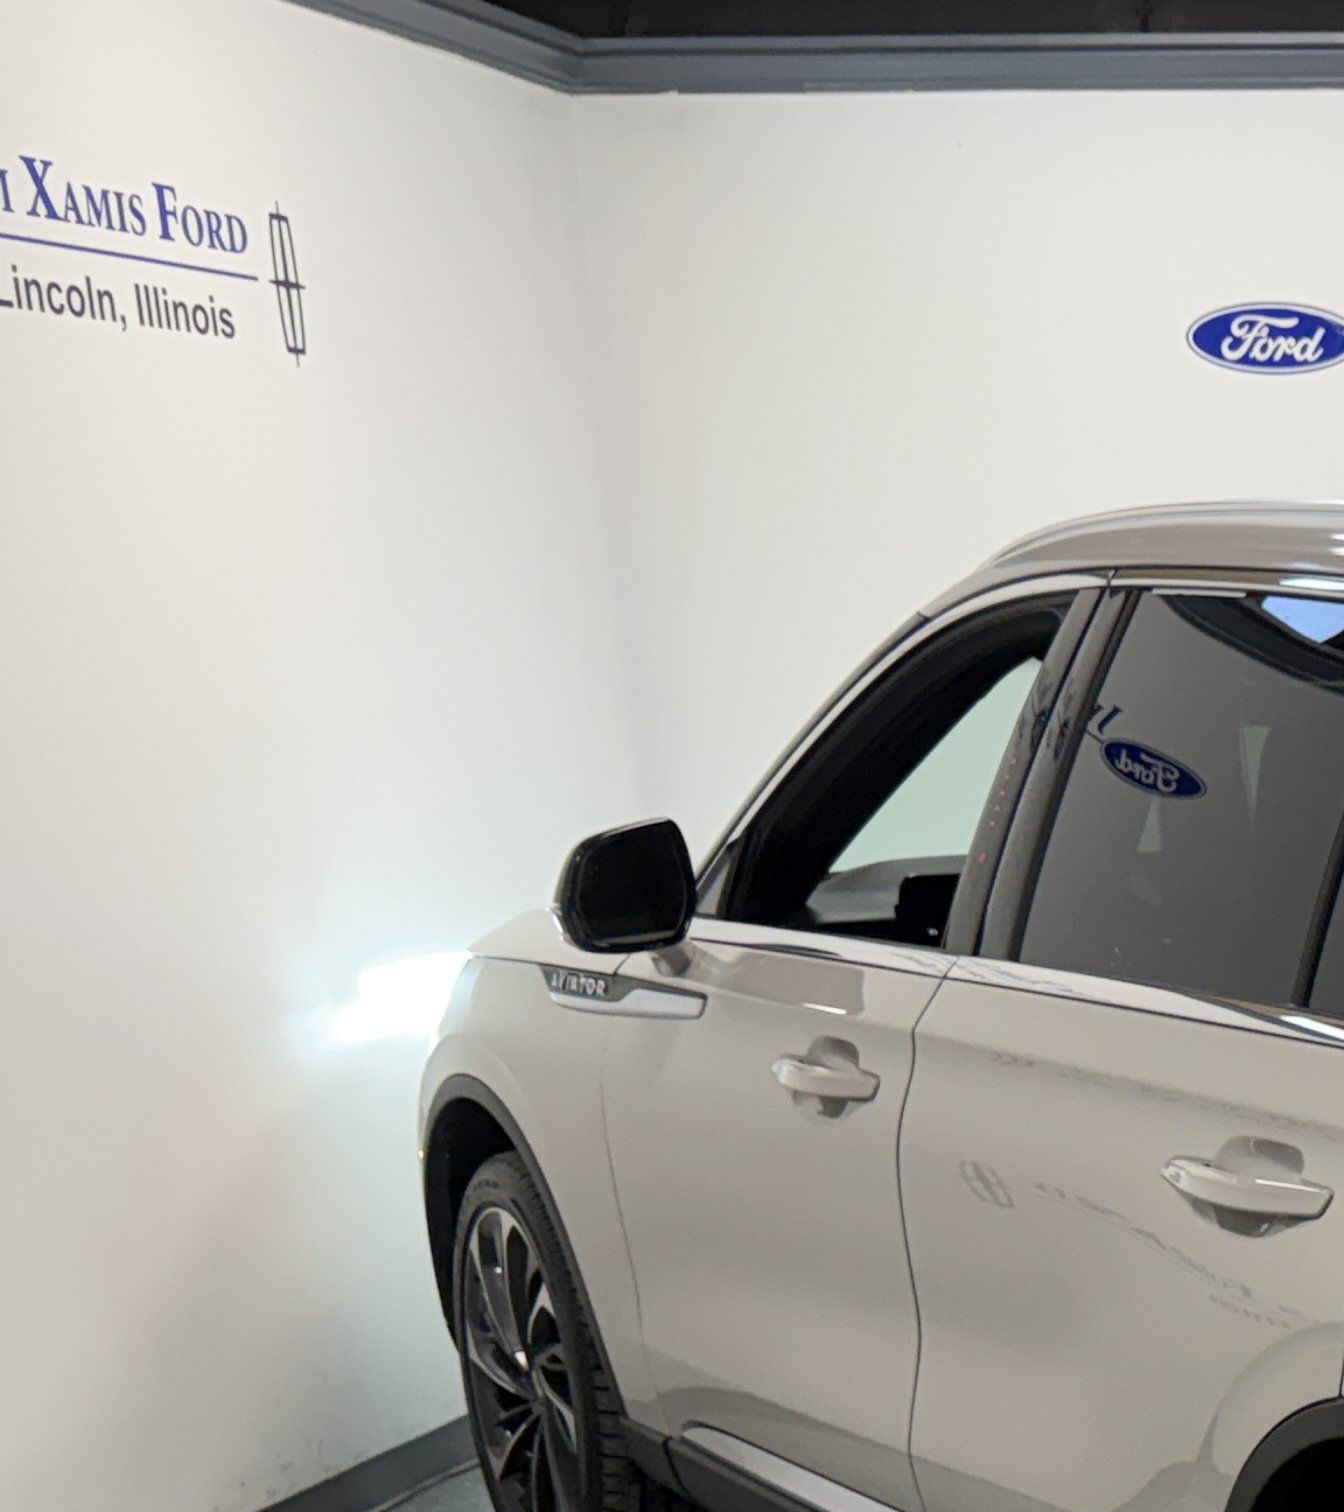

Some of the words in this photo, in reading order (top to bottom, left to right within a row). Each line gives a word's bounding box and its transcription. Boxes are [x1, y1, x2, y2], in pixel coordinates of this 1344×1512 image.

[18, 155, 147, 237] XAMIS
[151, 182, 248, 254] FORD
[134, 283, 236, 339] Illinois
[1220, 315, 1324, 364] Ford
